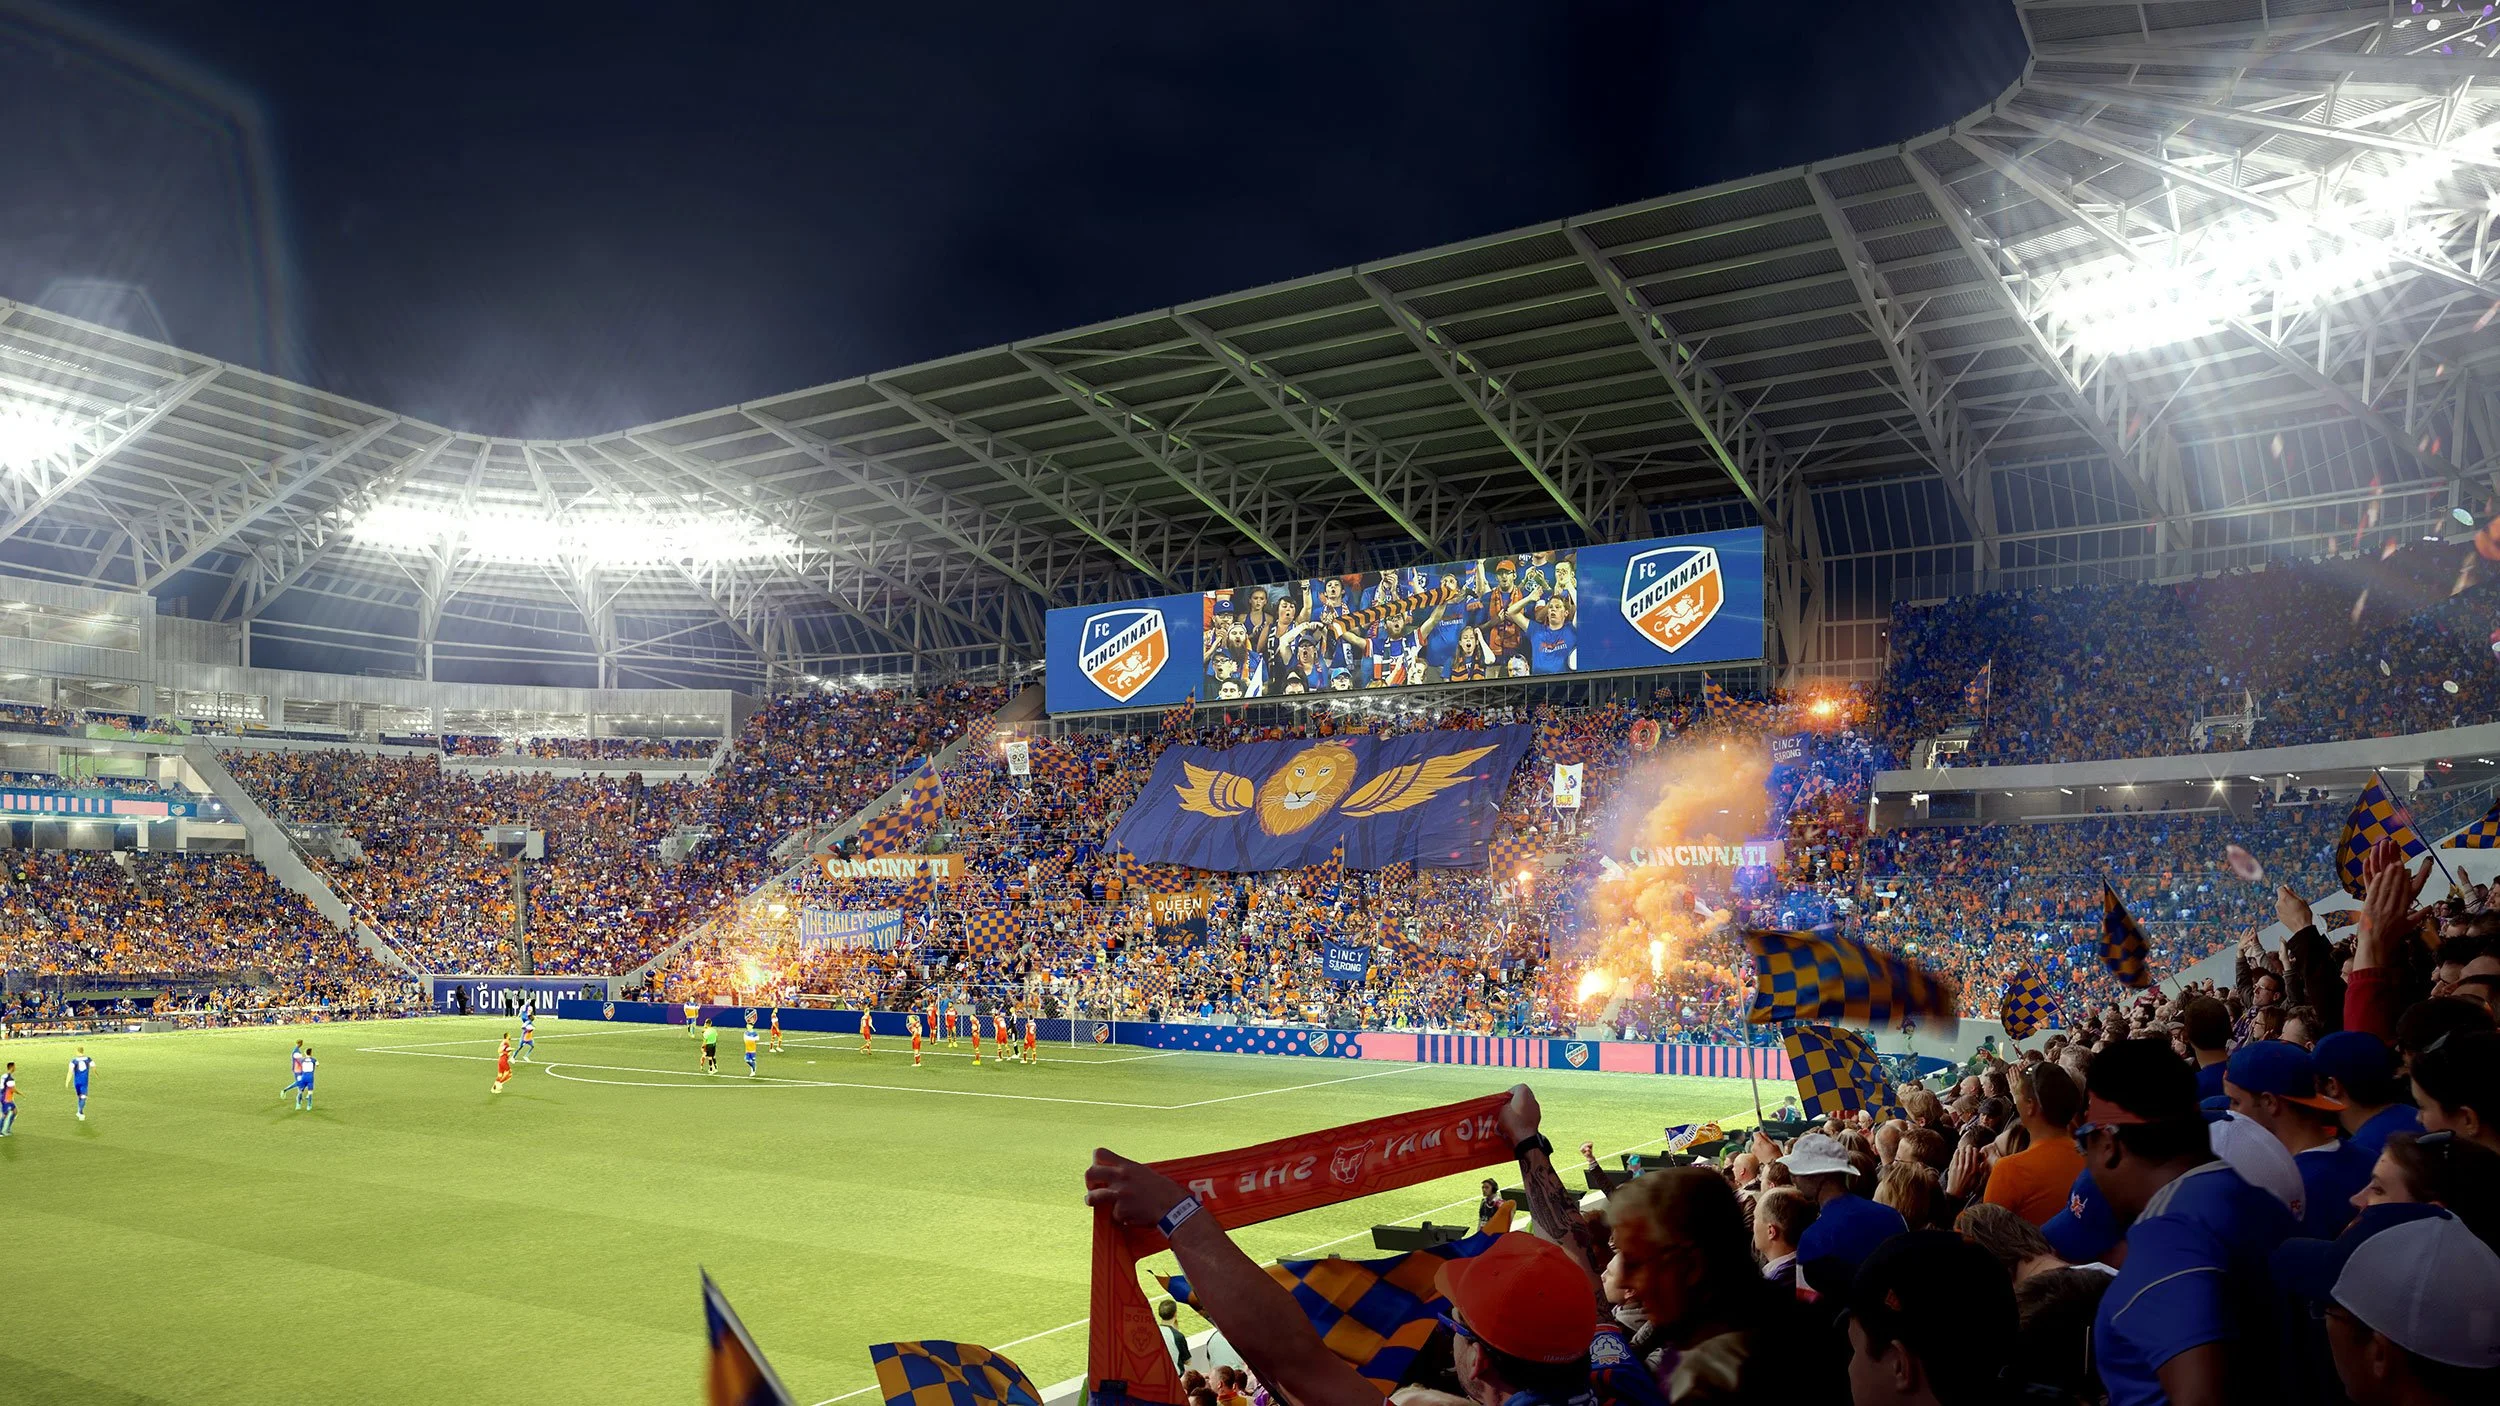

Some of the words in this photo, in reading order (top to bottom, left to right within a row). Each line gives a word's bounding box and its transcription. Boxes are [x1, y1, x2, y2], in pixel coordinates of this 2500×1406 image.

[1637, 562, 1656, 580] FC
[1630, 552, 1711, 618] CINCINNATI
[1095, 622, 1110, 638] FC
[1087, 614, 1158, 672] CINCINNATI
[1772, 738, 1802, 751] CINCY
[1630, 845, 1767, 867] CINCINNATI
[827, 857, 949, 879] CINCINNTI
[1156, 898, 1202, 911] QUEEN
[804, 910, 825, 935] THE
[826, 911, 866, 934] BAILEY
[867, 909, 901, 928] SINGS
[1164, 909, 1193, 921] CITY
[1330, 948, 1363, 962] CINCY
